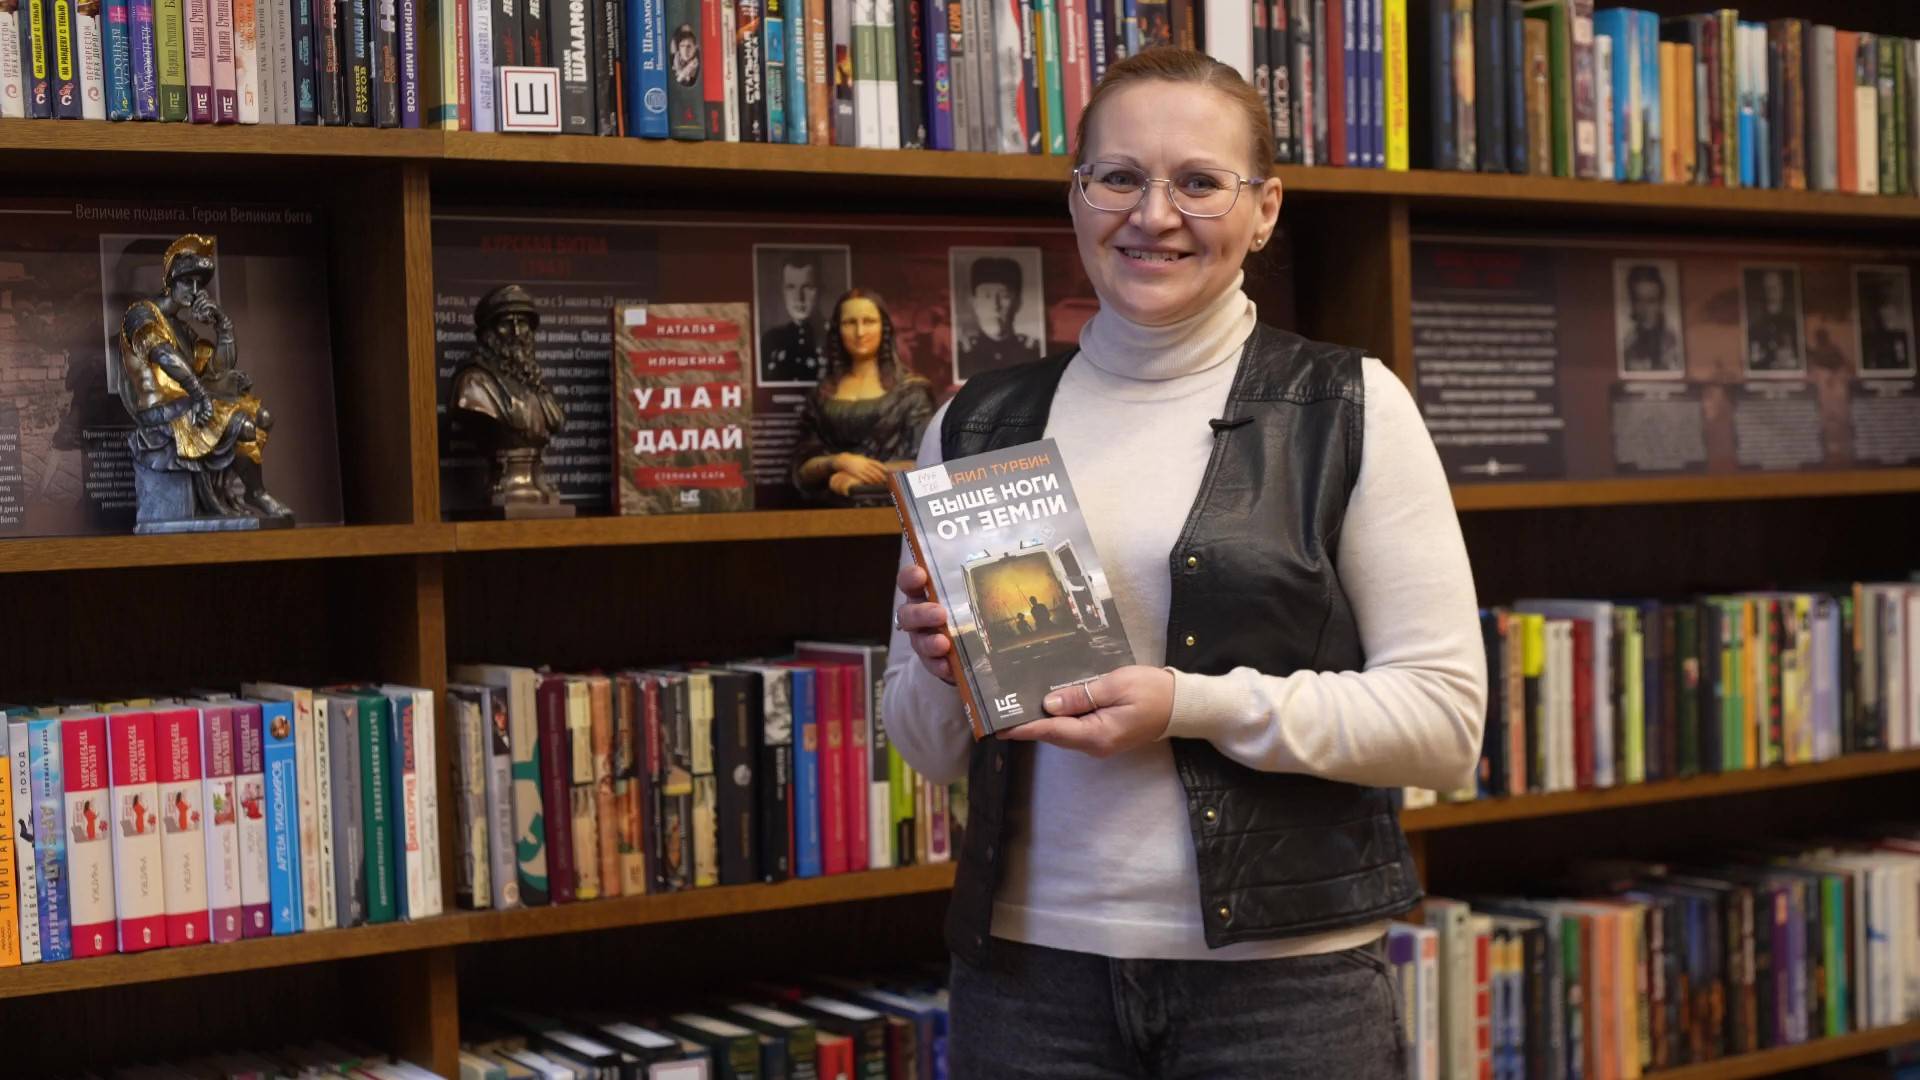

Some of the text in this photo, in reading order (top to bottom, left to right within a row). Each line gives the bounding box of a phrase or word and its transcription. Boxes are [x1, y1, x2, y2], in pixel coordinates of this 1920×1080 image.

[569, 0, 587, 82] ШАЛАМО
[642, 0, 653, 53] Шаламо
[406, 53, 414, 79] МИР
[406, 82, 415, 113] ПСОВ
[75, 203, 131, 222] Величие
[133, 207, 190, 224] подвига.
[192, 207, 228, 222] Герои
[230, 207, 282, 224] Великих
[657, 325, 716, 335] НАТАЛЬЯ
[648, 357, 726, 367] ИЛИШКИНА
[633, 385, 742, 410] УЛАН
[634, 426, 743, 454] ДАЛАЙ
[991, 453, 1051, 477] ТУРБИН
[928, 473, 1059, 517] ВЫШЕ НОГИ
[936, 494, 1068, 540] ОТ ЗЕМЛИ
[18, 750, 27, 795] ПОХОД
[271, 759, 287, 871] АРТЕМ ТИХОМИРОВ
